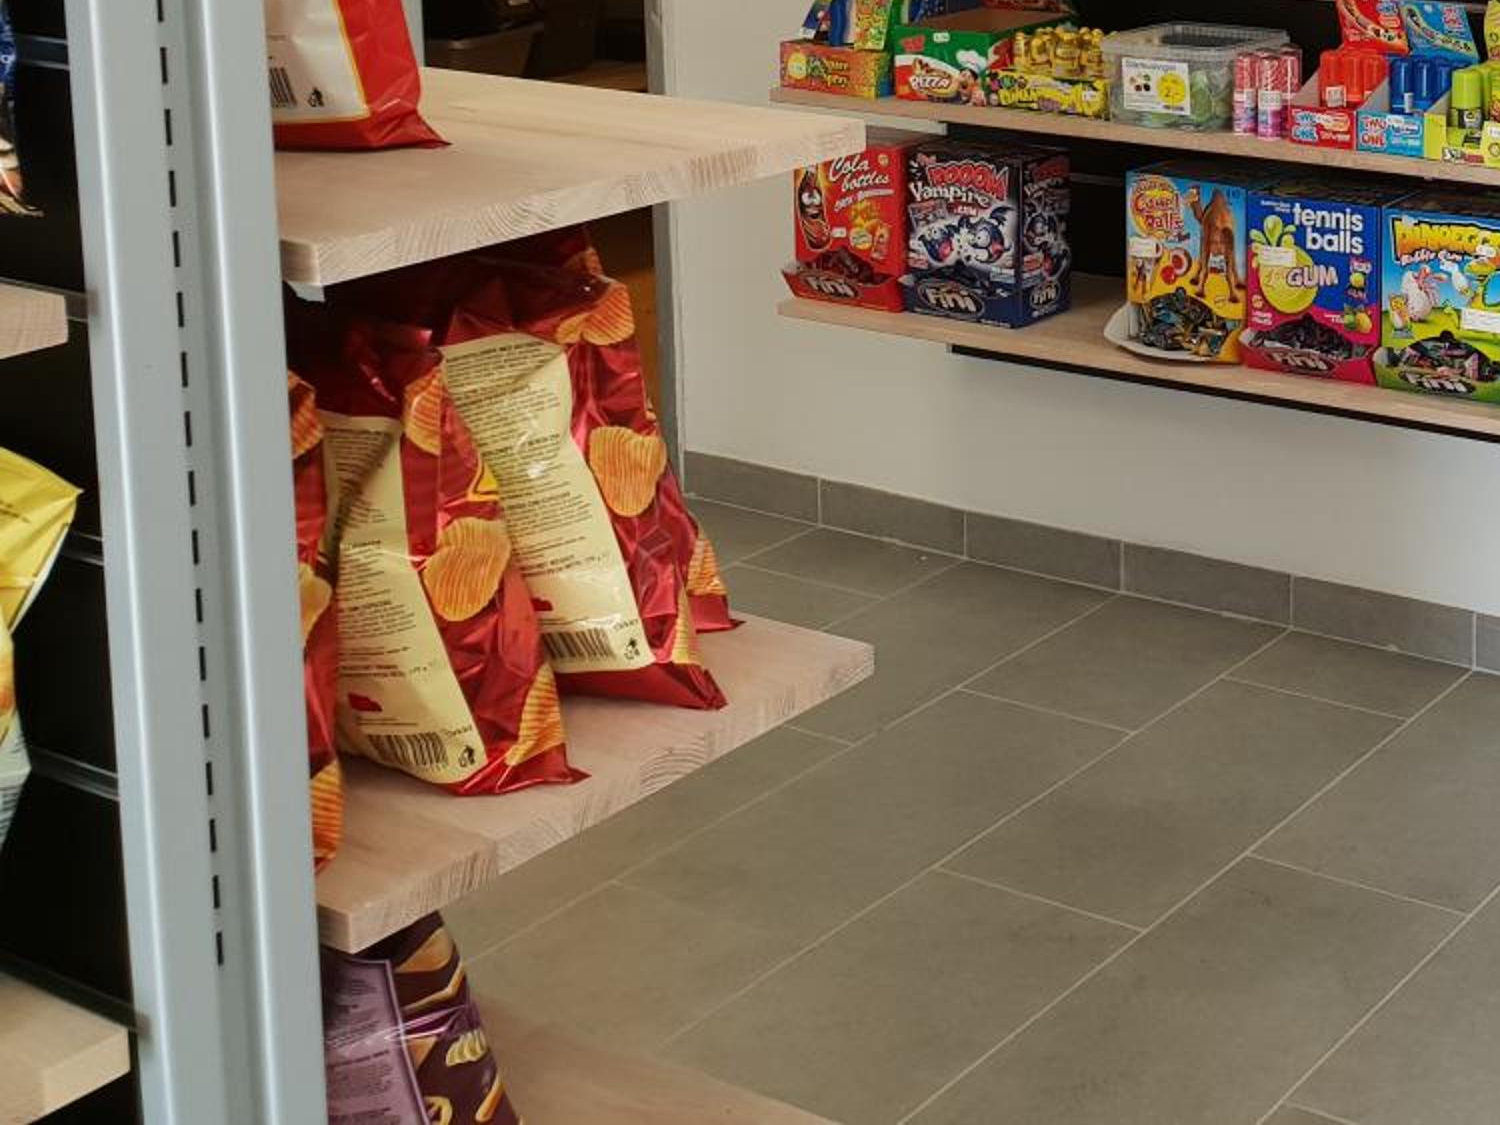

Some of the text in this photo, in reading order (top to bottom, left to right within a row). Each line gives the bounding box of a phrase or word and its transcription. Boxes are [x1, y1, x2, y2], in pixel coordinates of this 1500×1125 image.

[828, 156, 870, 181] Cola
[908, 180, 992, 207] Vampire
[1293, 202, 1363, 231] tennis
[1305, 228, 1364, 255] balls
[1286, 266, 1338, 287] GUM
[926, 284, 978, 312] Fini
